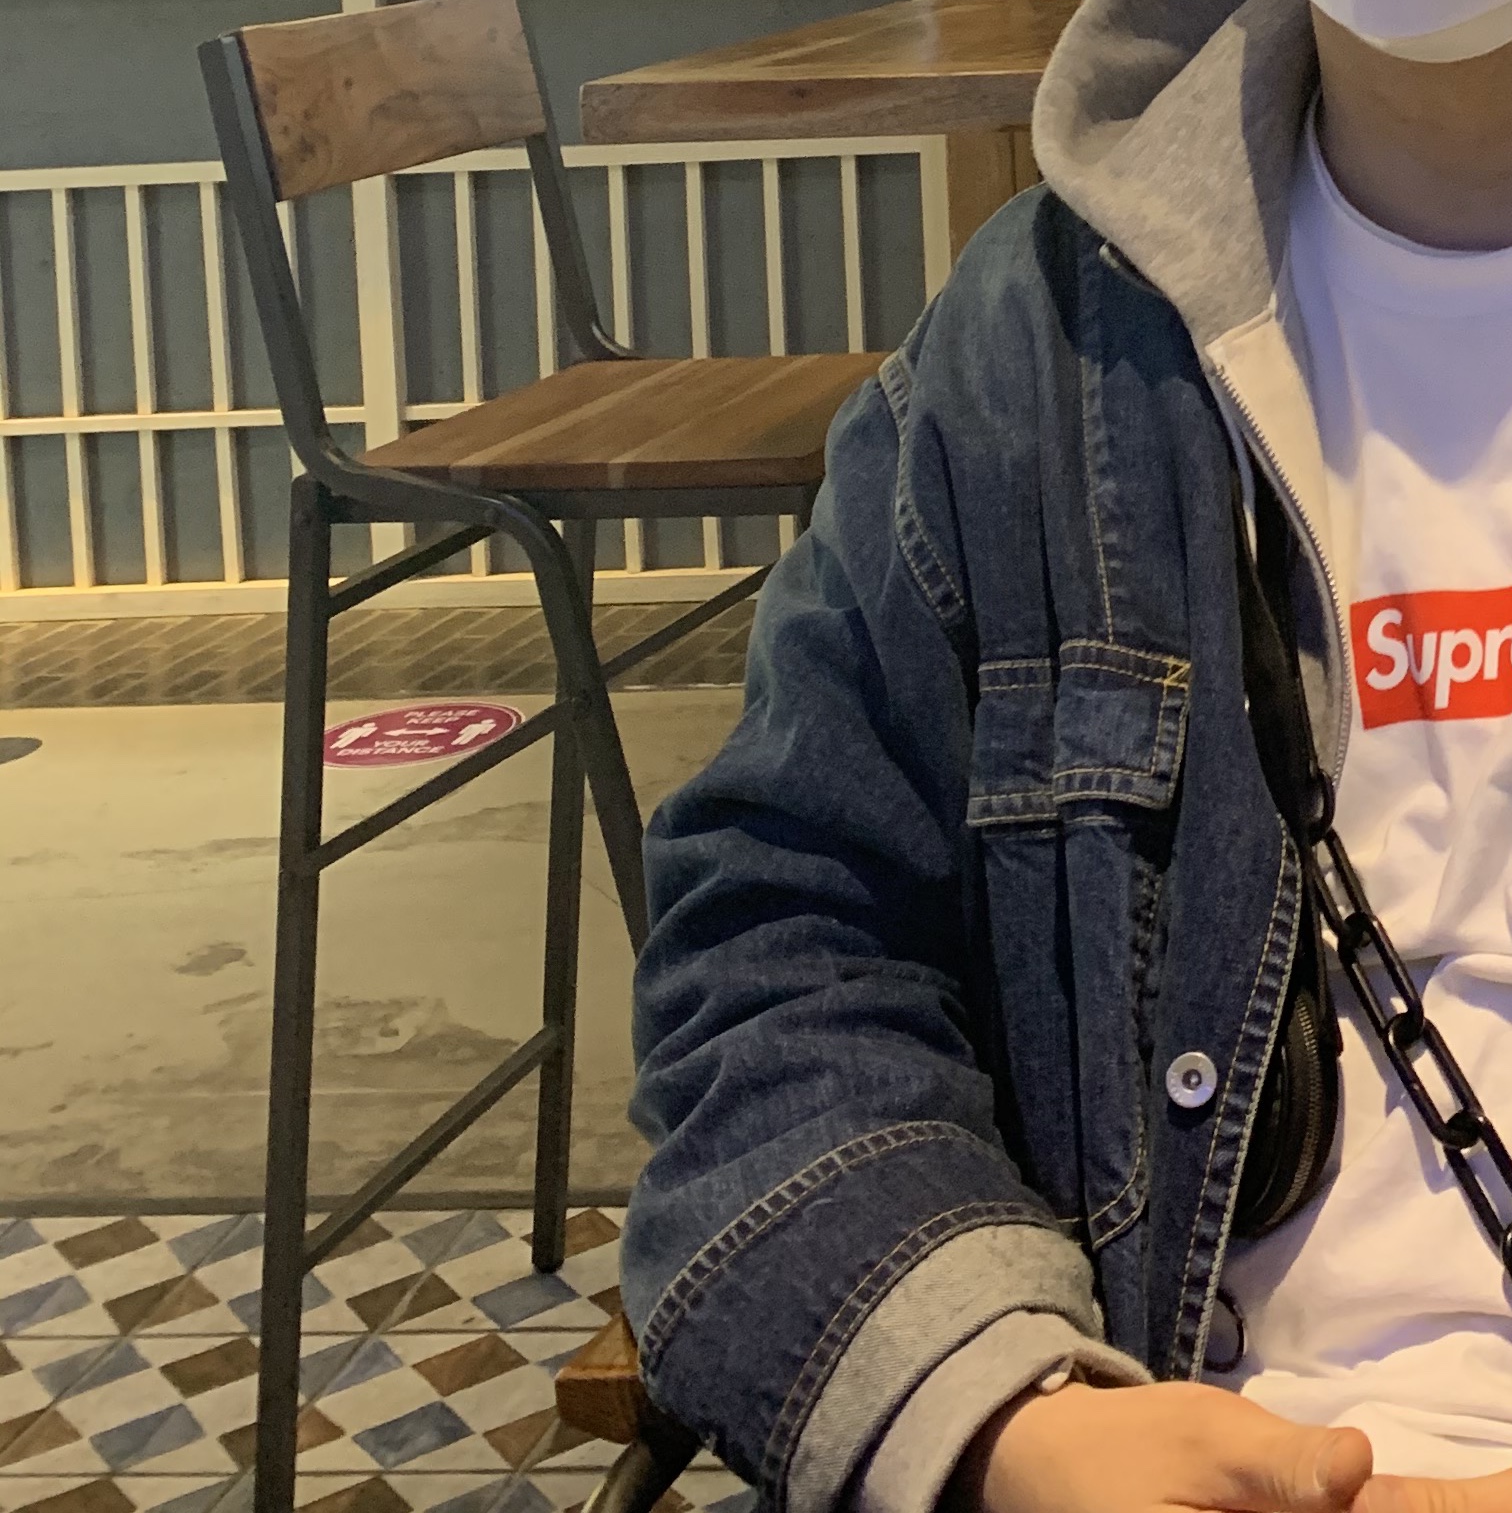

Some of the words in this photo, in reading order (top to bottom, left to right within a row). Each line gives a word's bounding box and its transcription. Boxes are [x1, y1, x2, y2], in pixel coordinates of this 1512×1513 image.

[404, 709, 480, 719] PLEASE
[406, 717, 460, 725] KEEP
[374, 739, 431, 748] YOUR
[336, 746, 445, 756] DISTANCE
